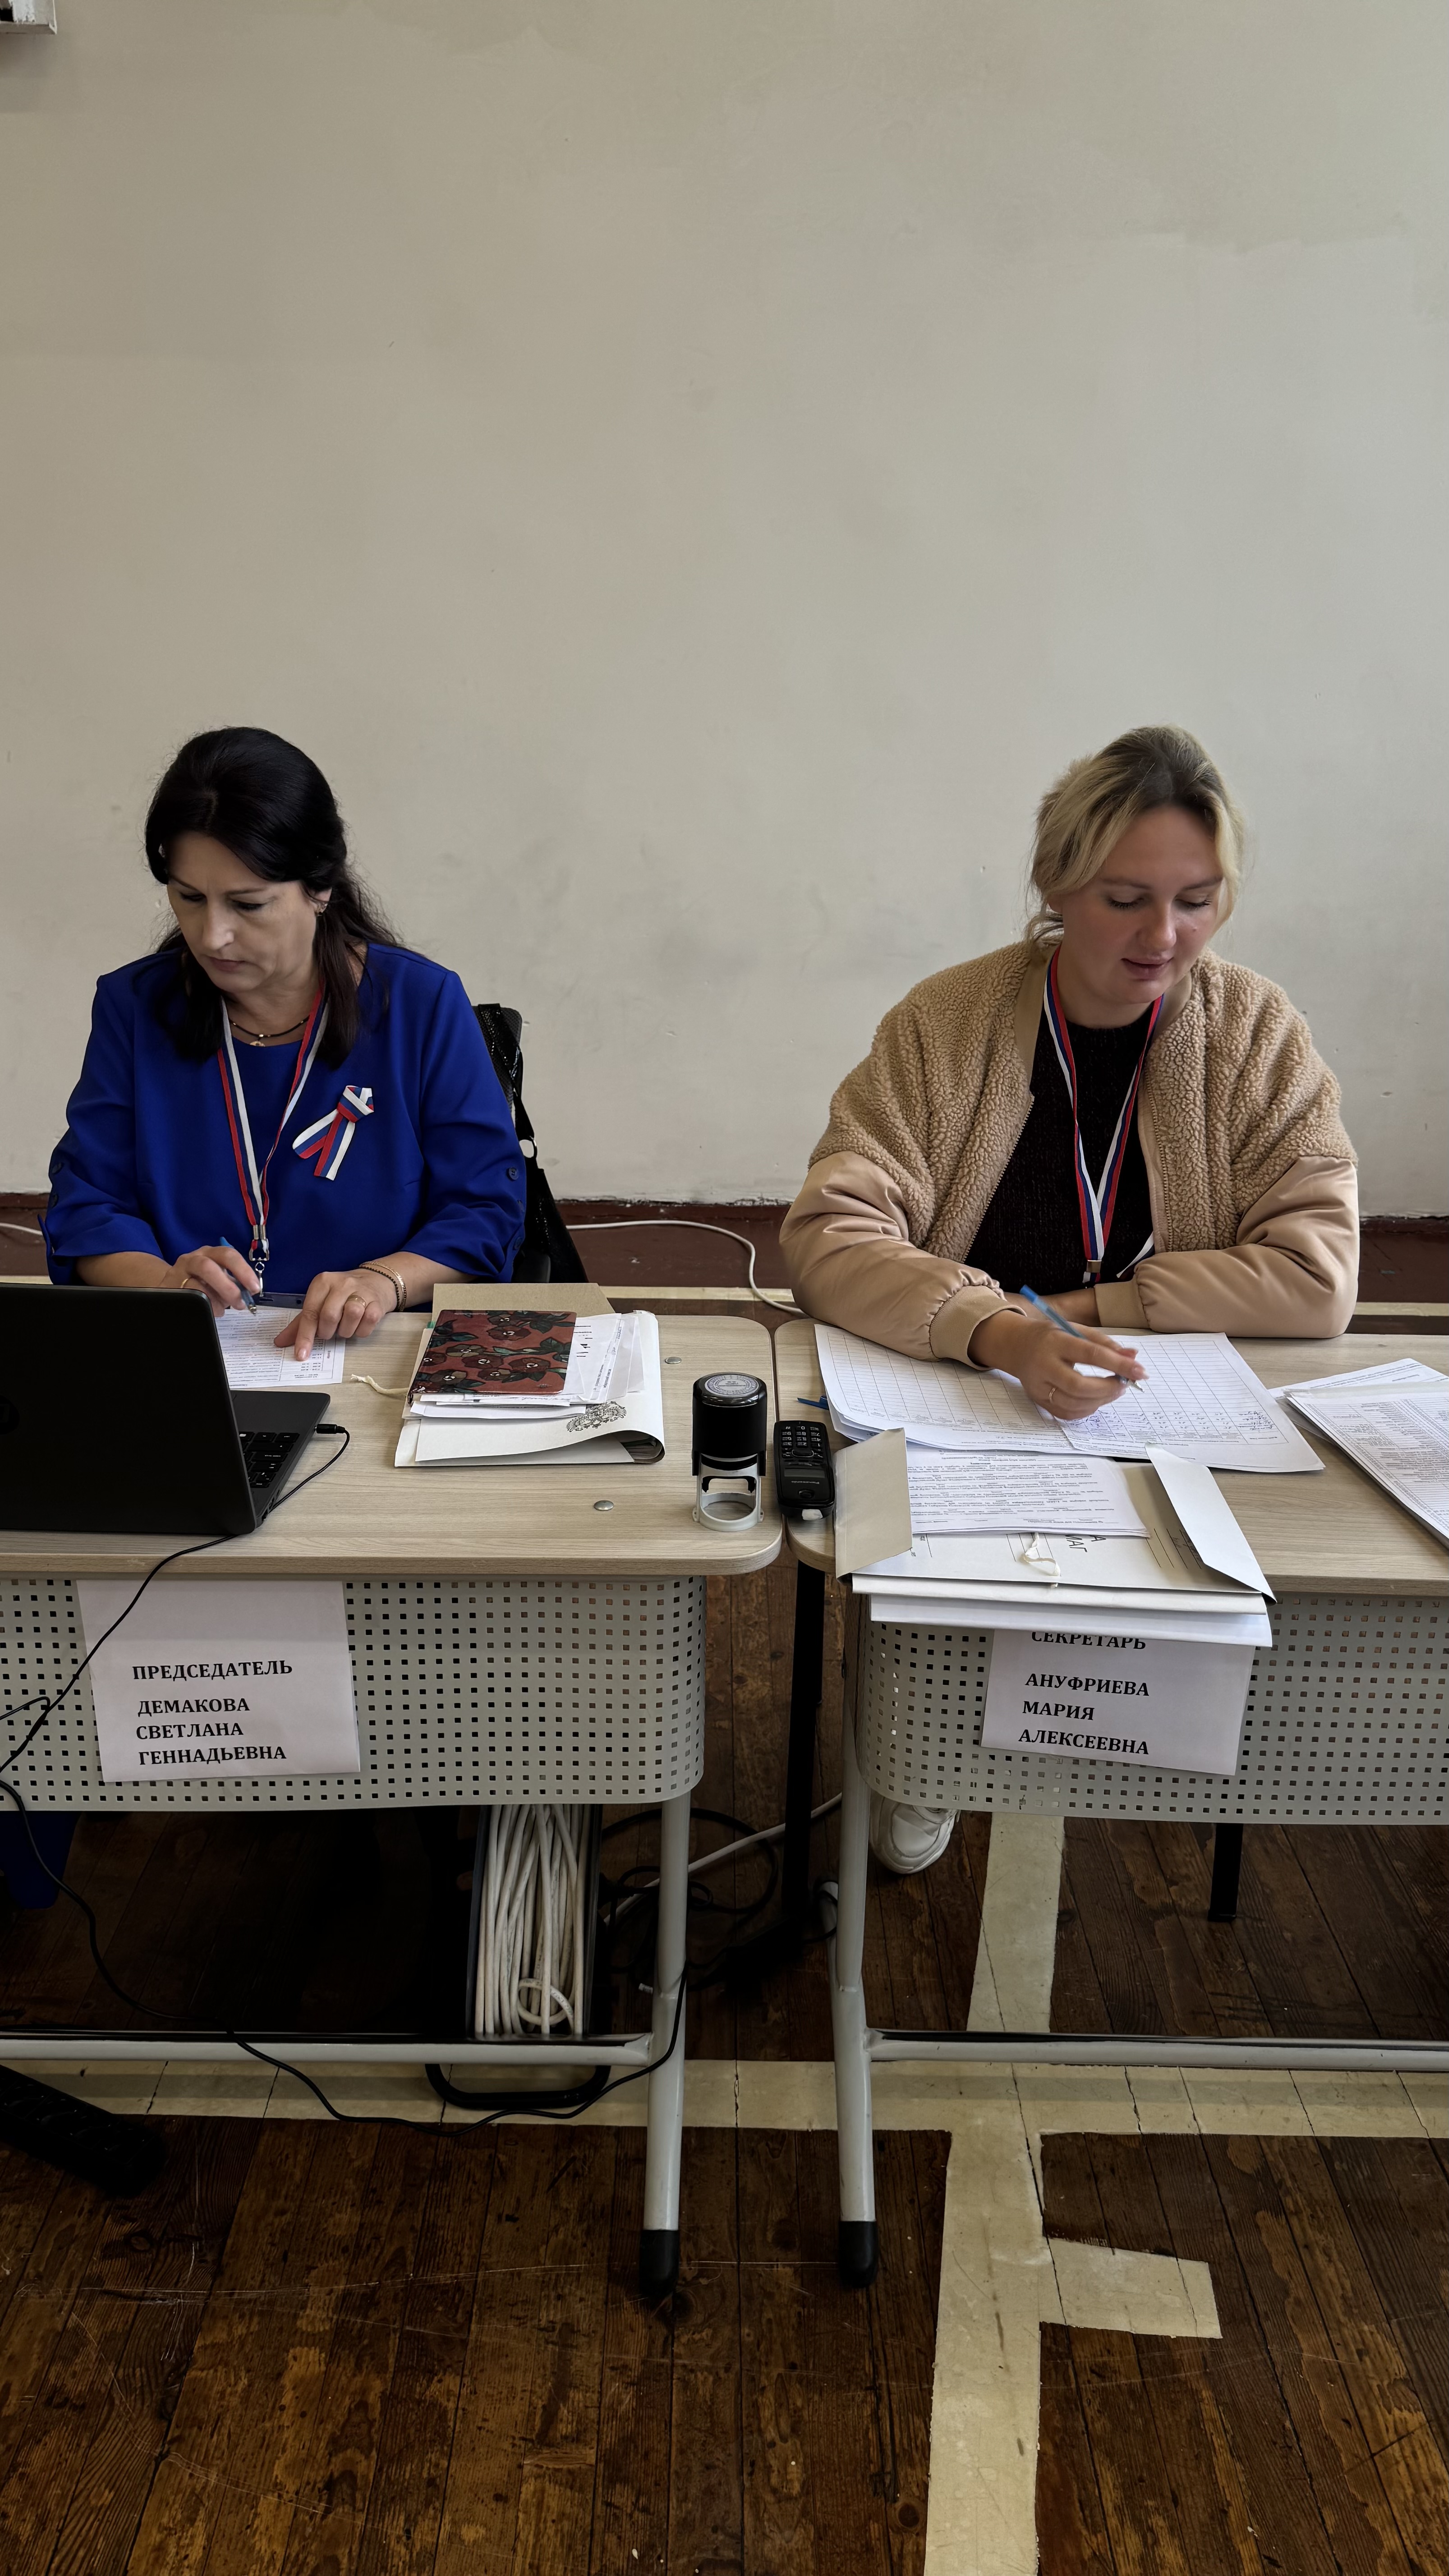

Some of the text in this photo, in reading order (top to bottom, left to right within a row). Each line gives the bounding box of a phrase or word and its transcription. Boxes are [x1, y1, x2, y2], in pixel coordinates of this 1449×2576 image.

[1031, 1631, 1146, 1650] СЕКРЕТАРЬ
[132, 1660, 292, 1682] ПРЕДСЕДАТЕЛЬ
[1025, 1673, 1150, 1696] АНУФРИЕВА
[138, 1698, 250, 1717] ДЕМАКОВА
[1022, 1701, 1095, 1720] МАРИЯ
[136, 1723, 244, 1739] СВЕТЛАНА
[1018, 1729, 1150, 1755] АЛЕКСЕЕВНА
[138, 1746, 287, 1765] ГЕННАДЬЕВНА
